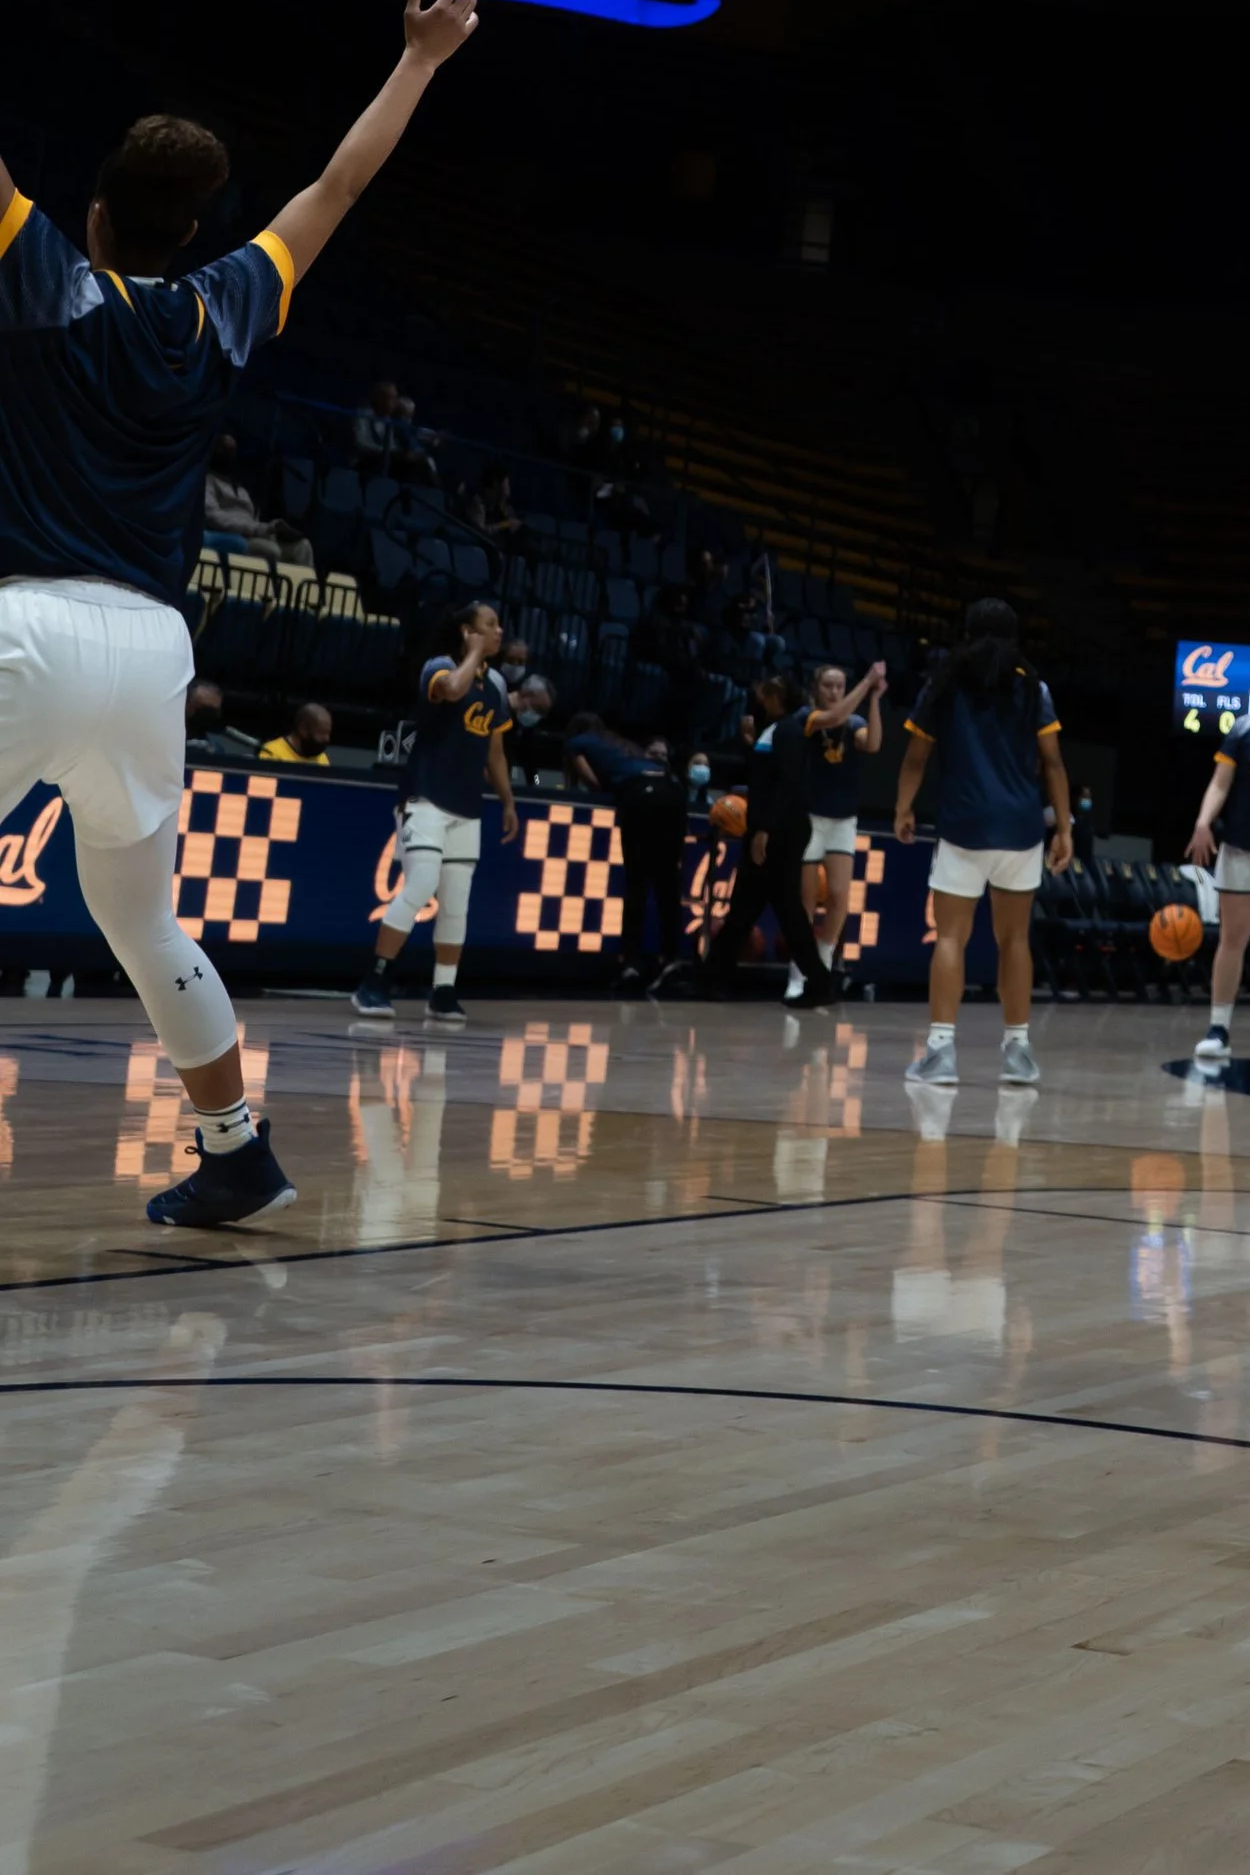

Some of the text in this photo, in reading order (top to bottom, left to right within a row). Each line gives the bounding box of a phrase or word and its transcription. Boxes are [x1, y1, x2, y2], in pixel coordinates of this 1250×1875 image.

[1181, 645, 1234, 688] Cal
[463, 701, 495, 737] Cal
[1183, 709, 1201, 734] 4
